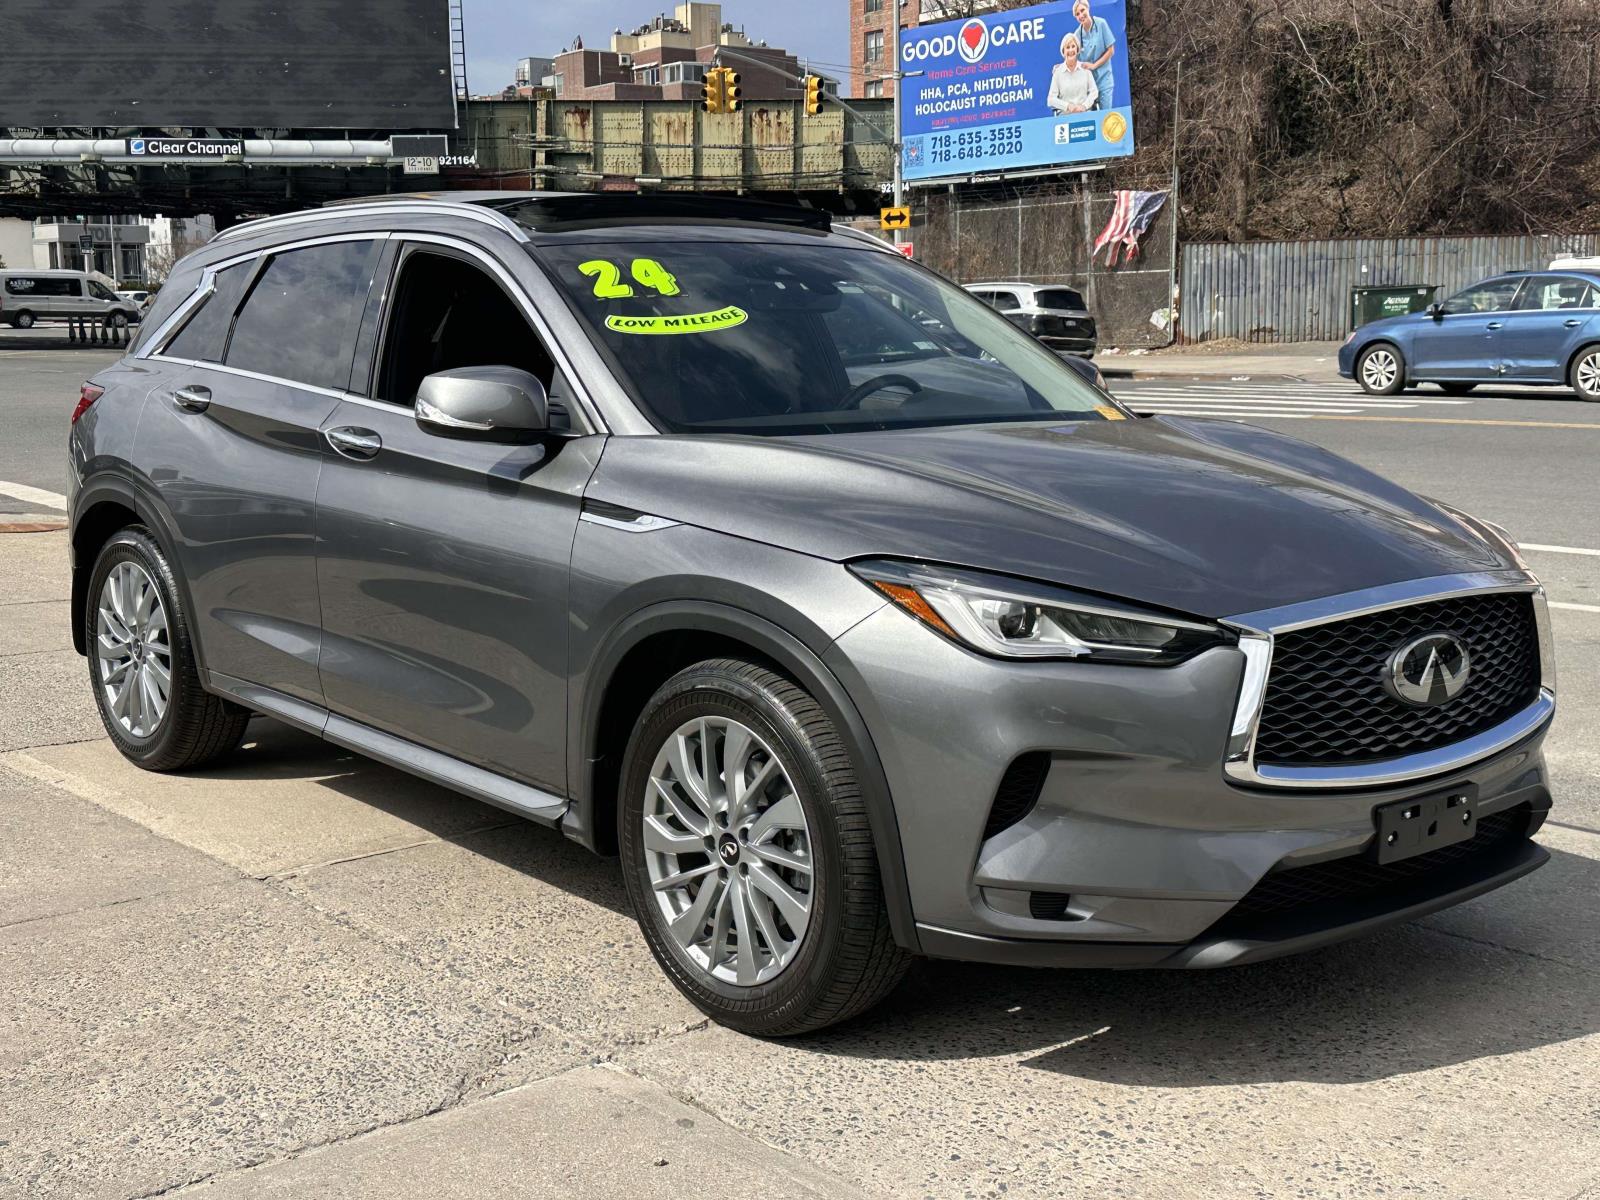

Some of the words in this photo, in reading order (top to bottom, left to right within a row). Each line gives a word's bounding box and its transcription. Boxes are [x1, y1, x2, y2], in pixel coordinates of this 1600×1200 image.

[902, 35, 956, 62] GOOD
[990, 17, 1046, 47] CARE
[928, 67, 953, 80] Home
[955, 64, 977, 76] Care
[978, 58, 1017, 73] Services
[920, 86, 945, 100] HHA,
[947, 82, 971, 97] PCA,
[974, 73, 1027, 92] NHTD/TBI,
[915, 97, 977, 116] HOLOCAUST
[979, 87, 1033, 107] PROGRAM
[148, 141, 185, 154] Clear
[187, 141, 242, 155] Channel
[931, 125, 1022, 149] 718-635-3535
[438, 155, 476, 165] 921164
[931, 140, 1023, 163] 718-648-2020
[577, 258, 681, 299] 24
[613, 319, 656, 327] LOW
[664, 309, 742, 327] MILEAGE
